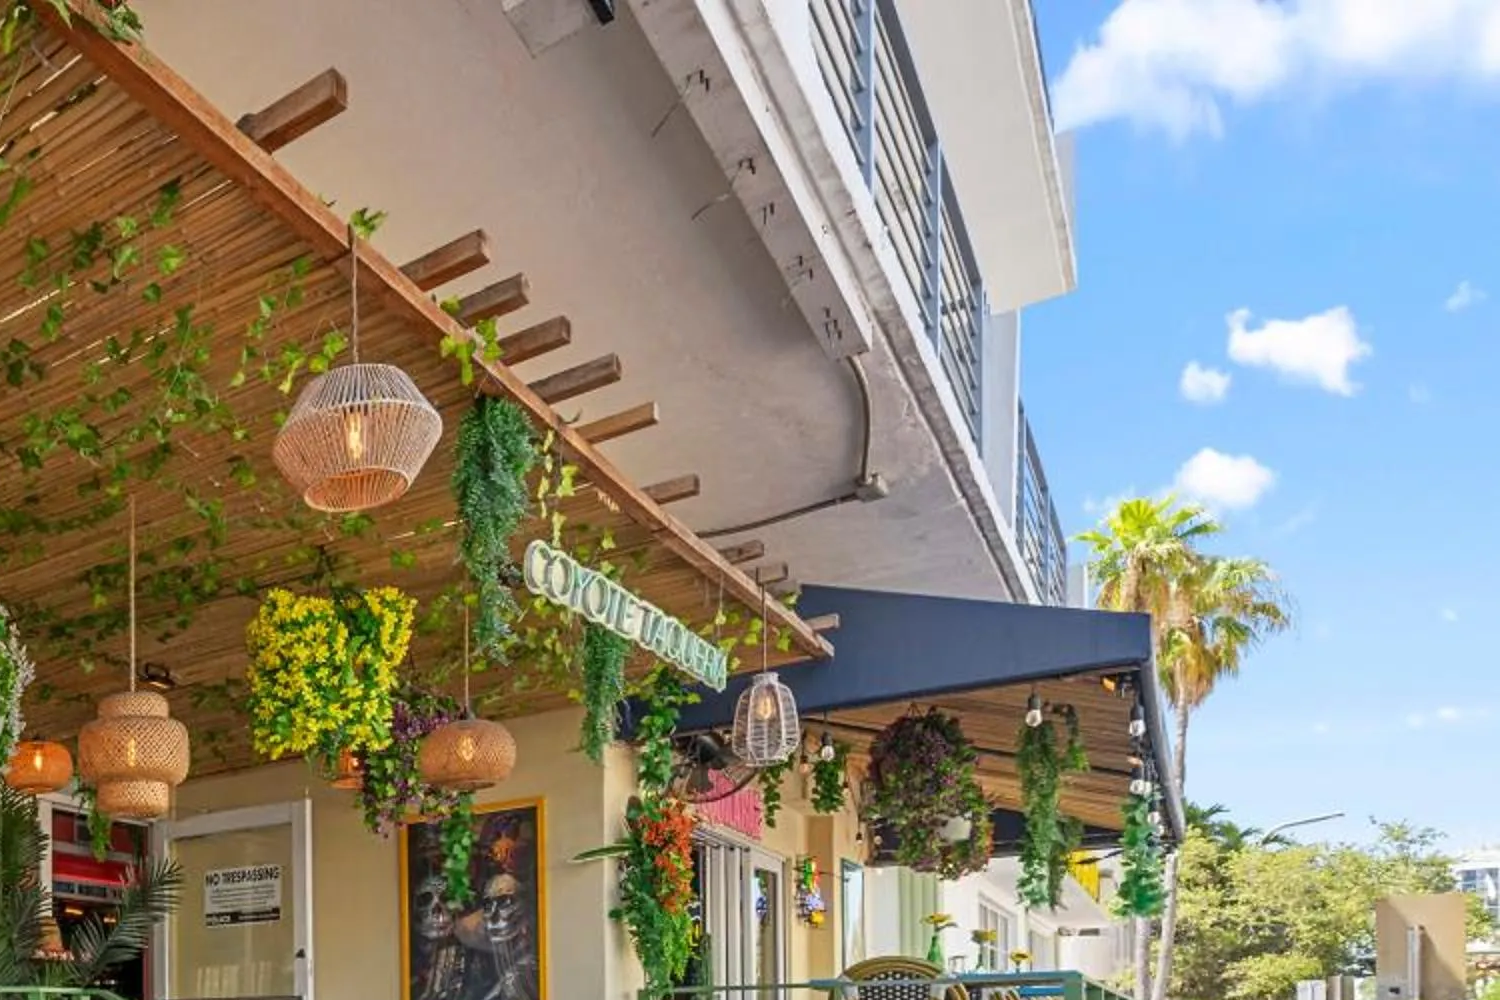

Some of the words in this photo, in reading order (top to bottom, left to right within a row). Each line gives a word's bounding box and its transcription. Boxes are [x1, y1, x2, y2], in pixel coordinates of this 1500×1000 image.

[525, 541, 640, 640] COYOTE
[205, 872, 220, 887] NO
[221, 866, 280, 884] TRESPASSING
